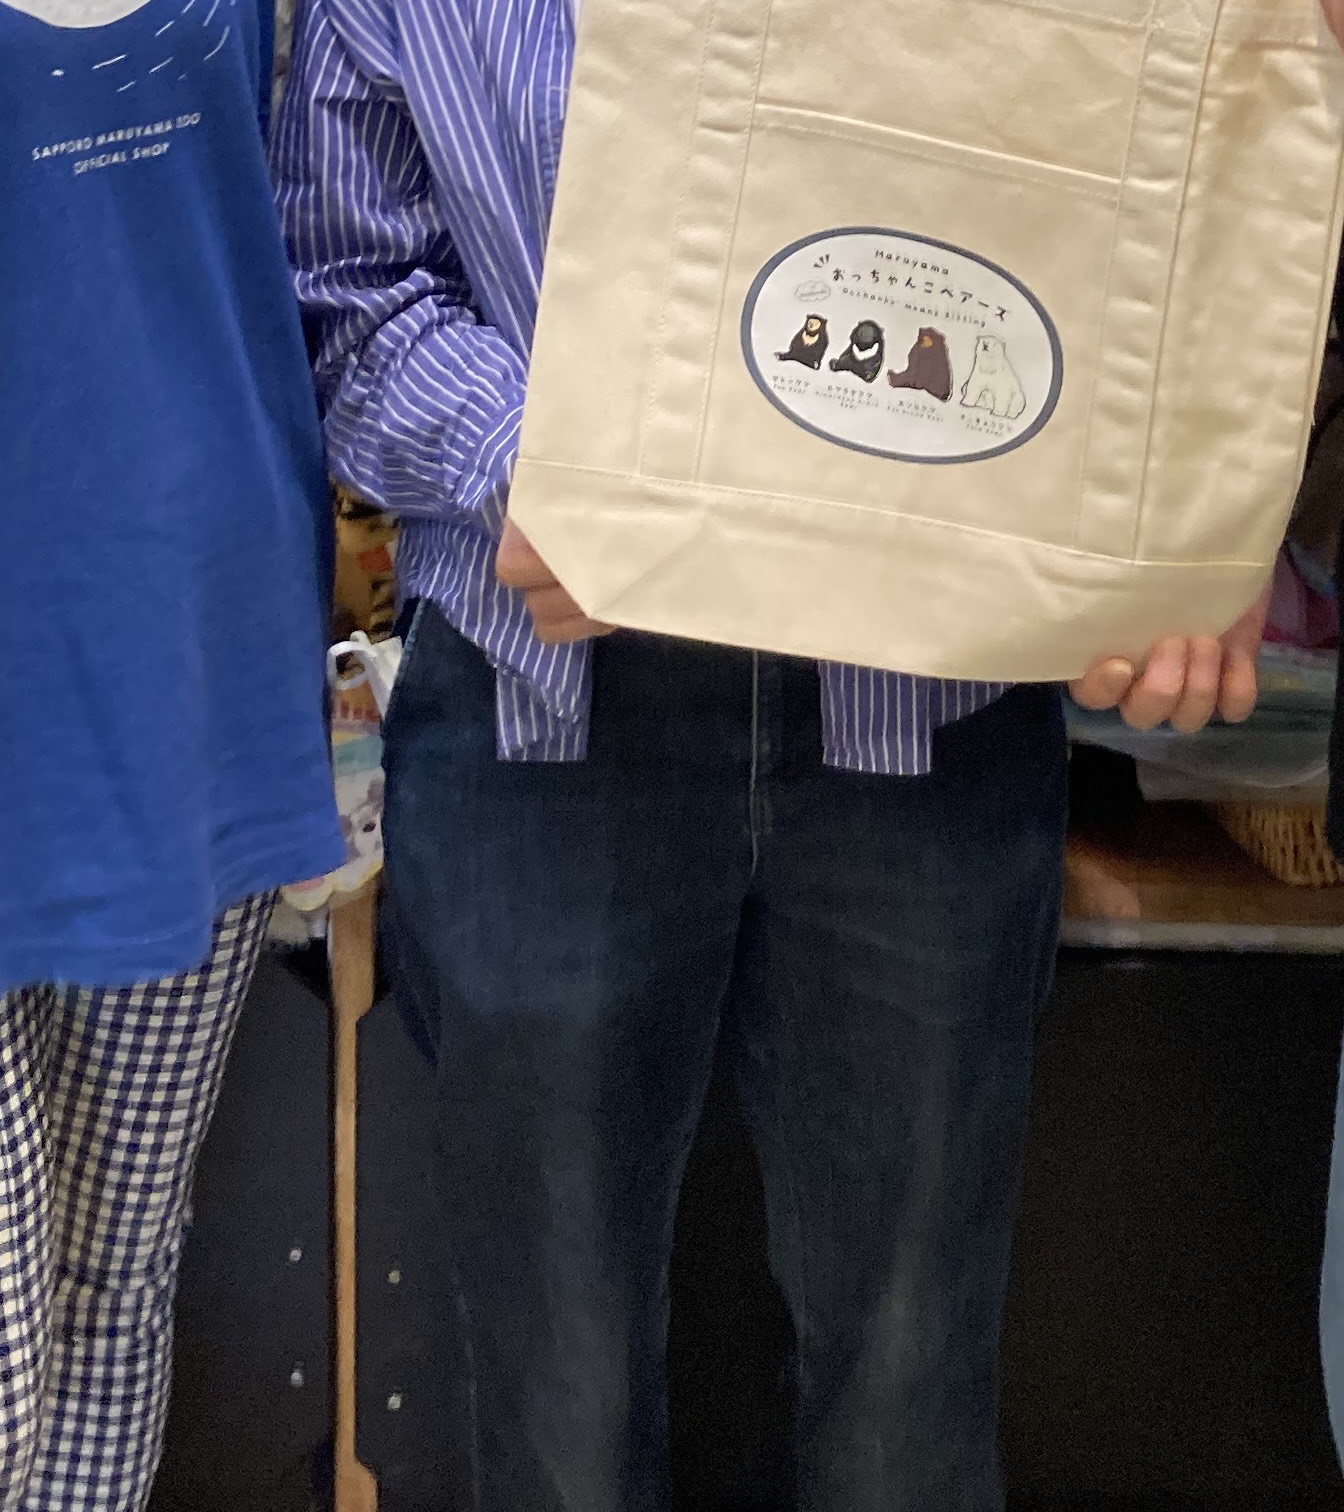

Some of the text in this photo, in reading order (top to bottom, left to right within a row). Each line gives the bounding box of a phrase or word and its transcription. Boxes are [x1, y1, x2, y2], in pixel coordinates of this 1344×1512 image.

[32, 112, 202, 161] SAPPORO MARUYAMA ZOO
[72, 142, 171, 175] OFFICIAL SHOP
[874, 249, 949, 276] Maruyama
